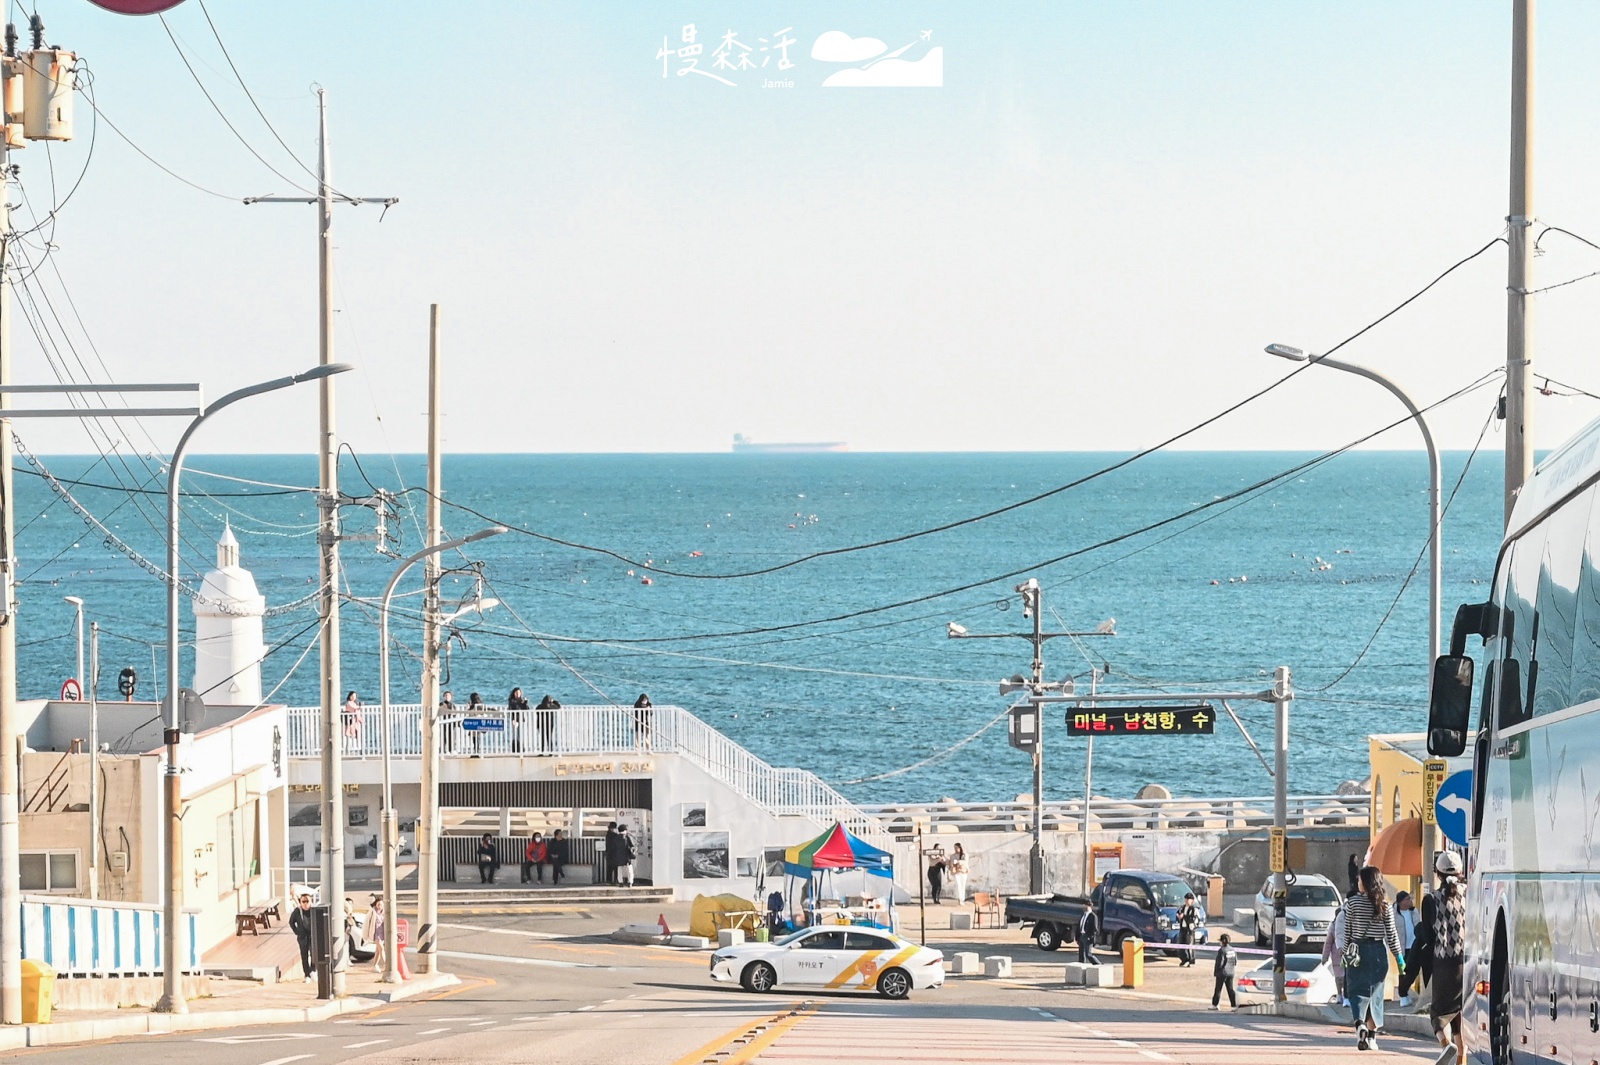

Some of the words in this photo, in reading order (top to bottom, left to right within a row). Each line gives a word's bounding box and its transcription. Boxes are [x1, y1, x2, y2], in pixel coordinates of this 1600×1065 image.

[1074, 713, 1115, 731] 미널,
[1124, 711, 1182, 730] 남천항,
[1192, 711, 1209, 729] 수
[798, 961, 817, 969] 카카오
[818, 961, 824, 969] T
